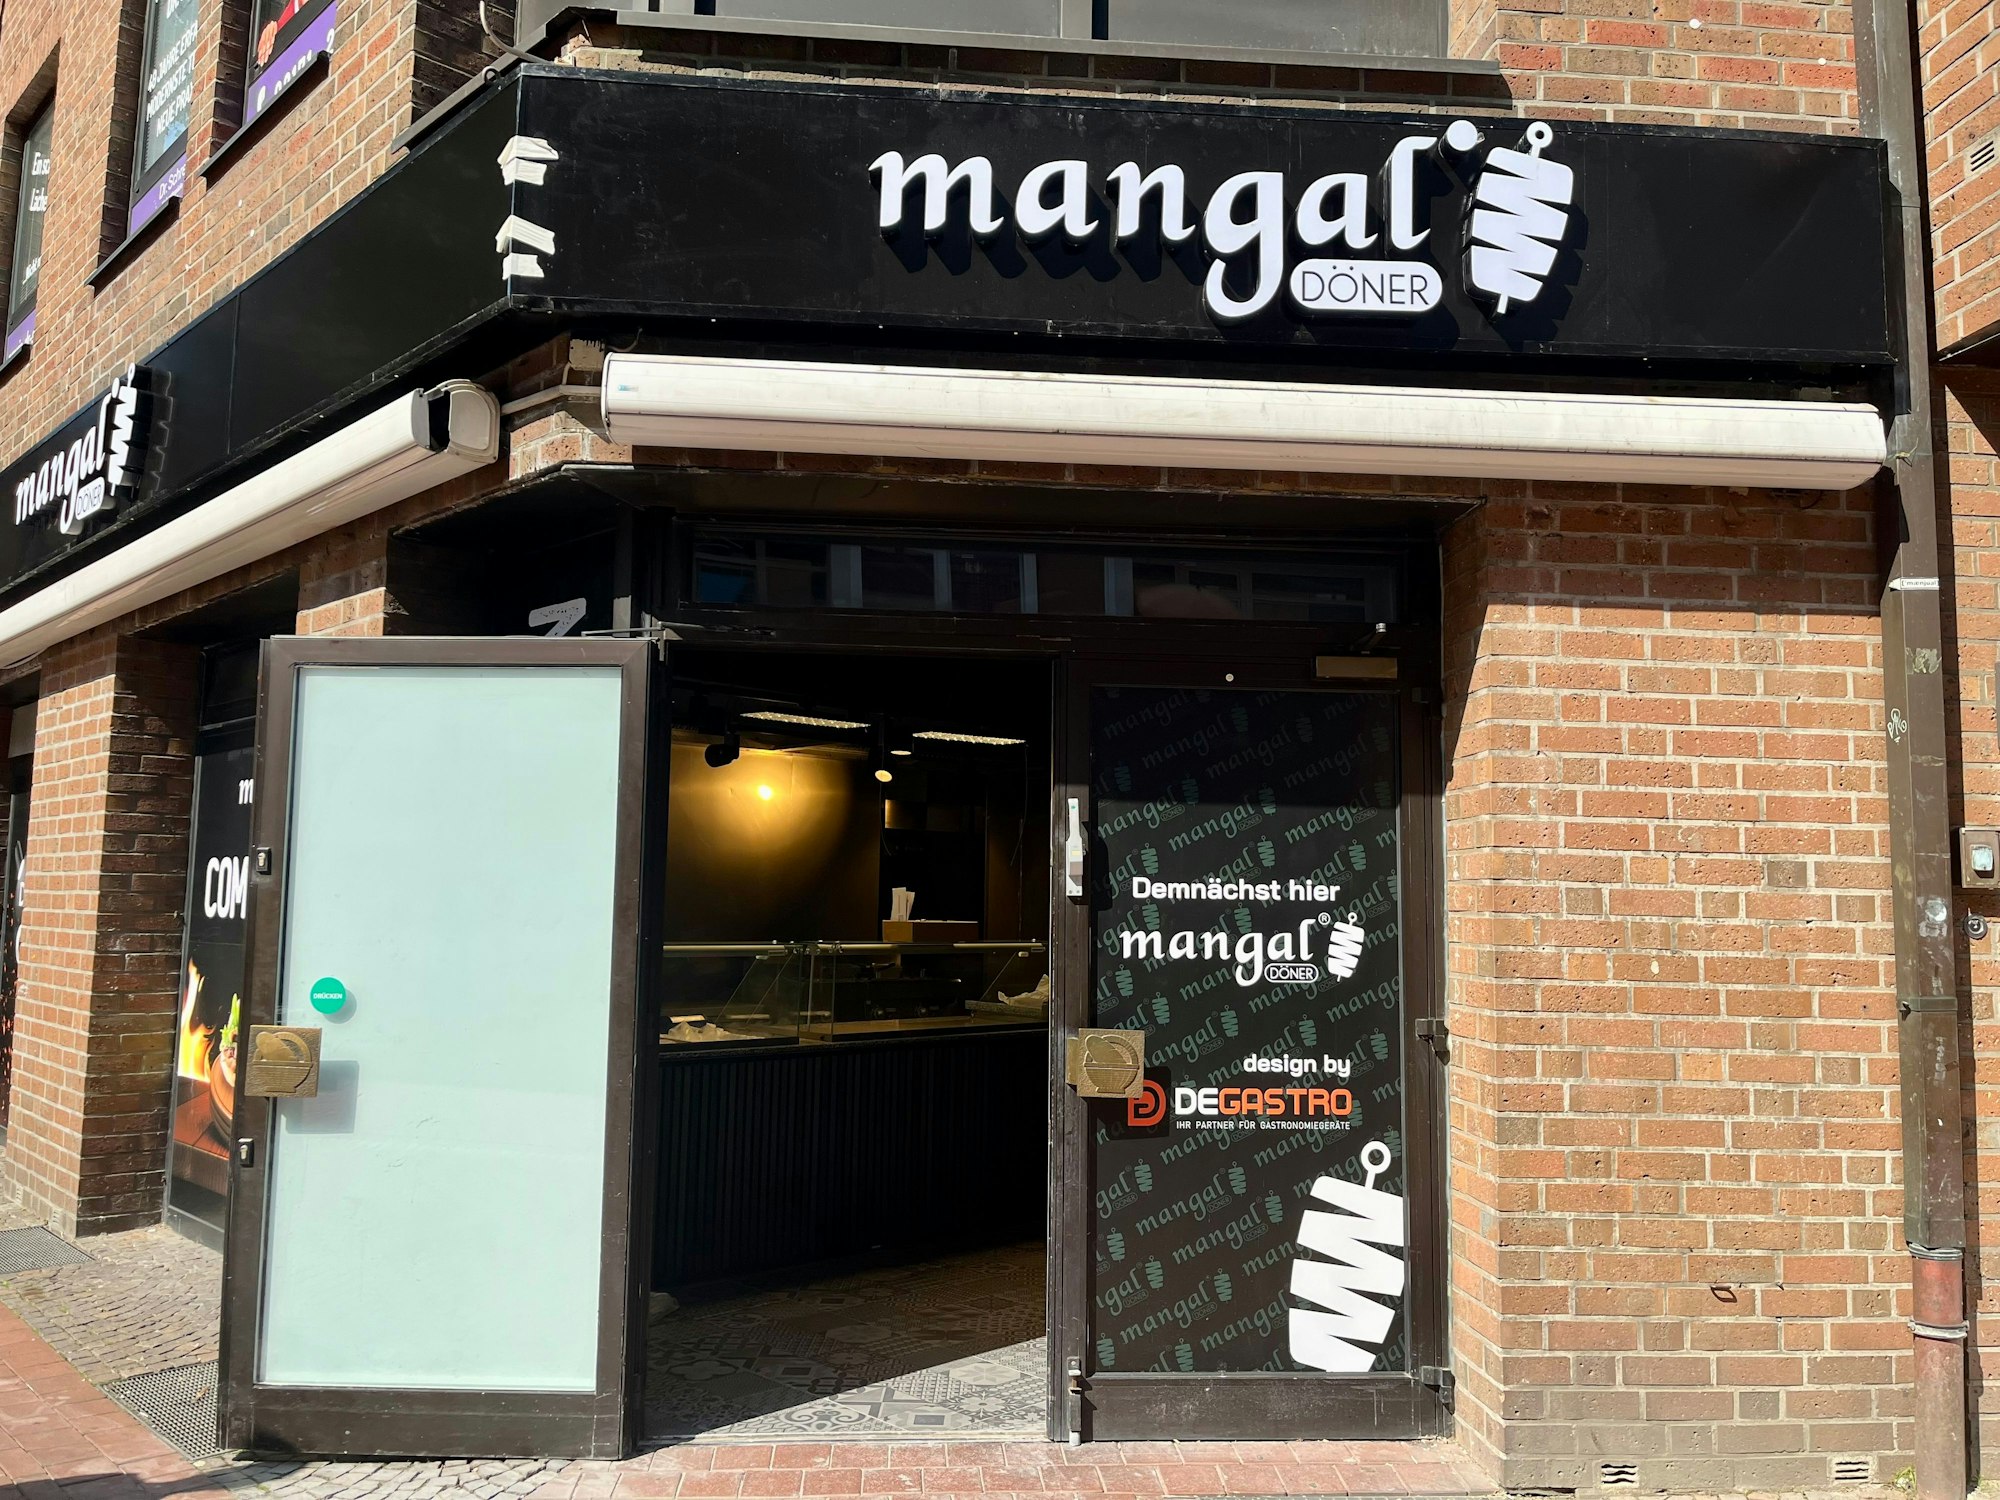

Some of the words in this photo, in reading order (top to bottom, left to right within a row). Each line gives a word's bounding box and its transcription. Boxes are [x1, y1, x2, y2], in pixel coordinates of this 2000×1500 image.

[147, 59, 188, 122] MODERNSTE
[868, 136, 1438, 319] mangal
[1302, 264, 1430, 306] DÖNER
[15, 393, 112, 534] mangal
[1168, 795, 1255, 852] mangal
[1284, 787, 1370, 845] mangal
[1132, 876, 1281, 901] Demnächst
[1289, 879, 1341, 902] hier
[1119, 918, 1316, 987] mangal
[1269, 965, 1315, 981] DÖNER
[1243, 1053, 1317, 1078] design
[1323, 1053, 1351, 1078] by
[1174, 1087, 1354, 1117] DEGASTRO
[1176, 1120, 1191, 1130] IHR
[1195, 1120, 1235, 1130] PARTNER
[1238, 1119, 1256, 1130] FÜR
[1259, 1119, 1351, 1130] GASTRONOMIEGERÄTE
[1135, 1173, 1226, 1236] mangal
[1172, 1202, 1261, 1264] mangal
[1120, 1280, 1211, 1344] mangal
[1200, 1289, 1289, 1353] mangal
